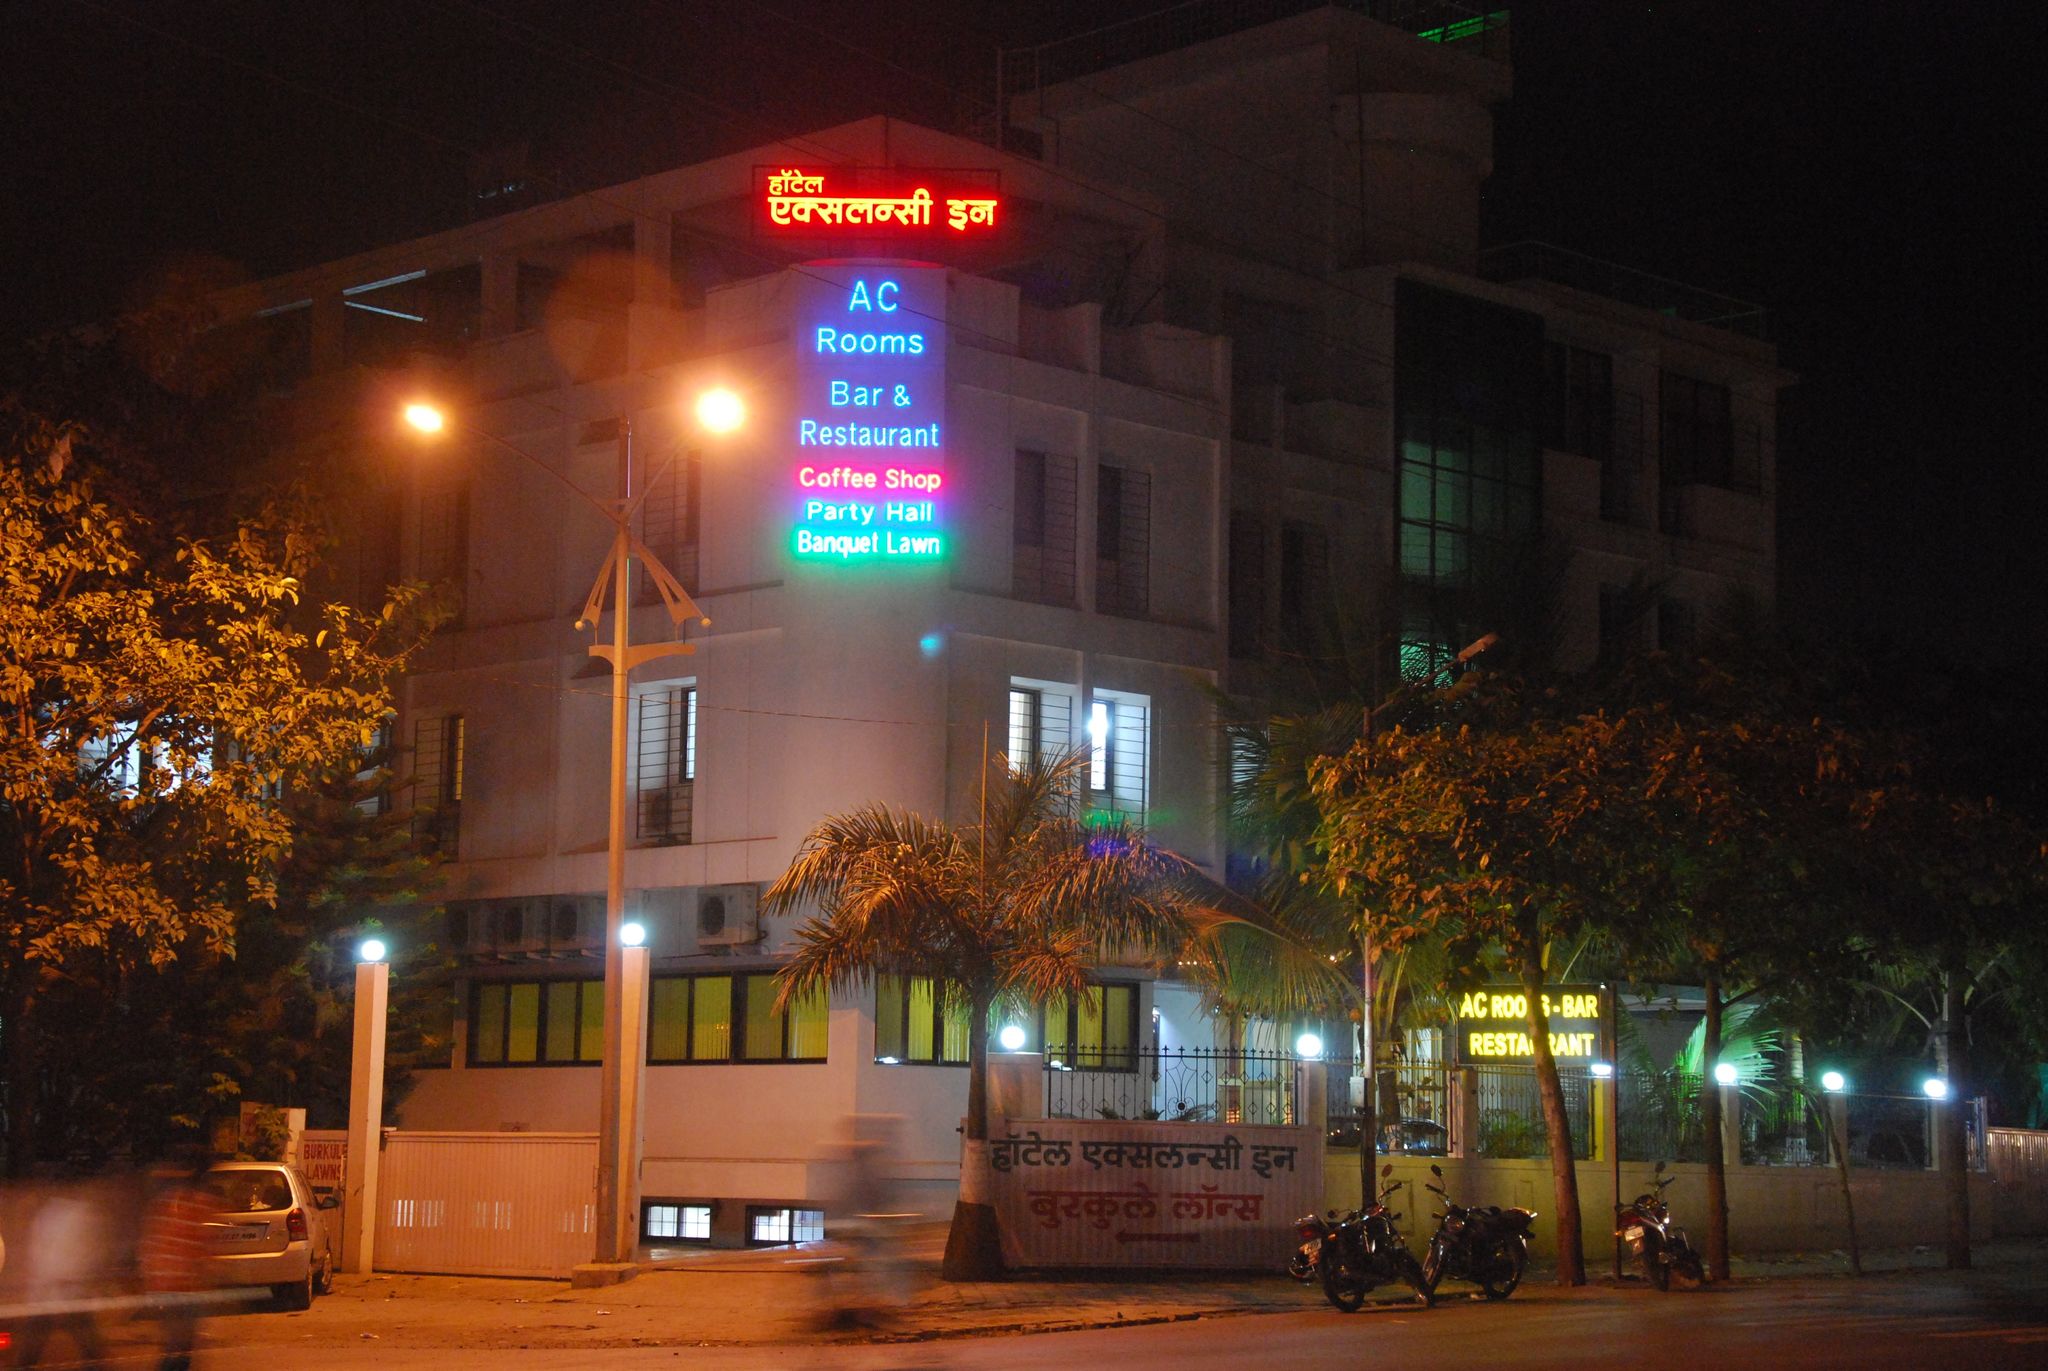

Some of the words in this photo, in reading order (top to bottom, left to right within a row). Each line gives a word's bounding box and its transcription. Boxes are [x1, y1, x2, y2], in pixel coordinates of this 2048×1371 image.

[768, 169, 824, 196] हॉटेल
[768, 188, 933, 225] एक्सलन्सी
[947, 199, 997, 230] इन
[849, 280, 899, 312] AC
[817, 327, 924, 354] Rooms
[831, 380, 883, 406] Bar
[893, 384, 911, 407] &
[800, 419, 939, 447] Restaurant
[799, 467, 877, 488] Coffee
[884, 468, 942, 493] Shop
[807, 501, 875, 526] Party
[886, 502, 934, 522] Hall
[797, 529, 879, 559] Banquet
[886, 530, 941, 555] Lawn
[1459, 991, 1488, 1019] AC
[1491, 993, 1551, 1019] ROOS
[1562, 993, 1599, 1018] BAR
[1469, 1032, 1595, 1057] RESTARANT
[990, 1131, 1072, 1172] हॉटेल
[1080, 1134, 1243, 1170] एक्सलन्सी
[1250, 1144, 1298, 1179] इन
[1027, 1181, 1159, 1229] बुरकुले
[1170, 1183, 1264, 1221] लॉन्स
